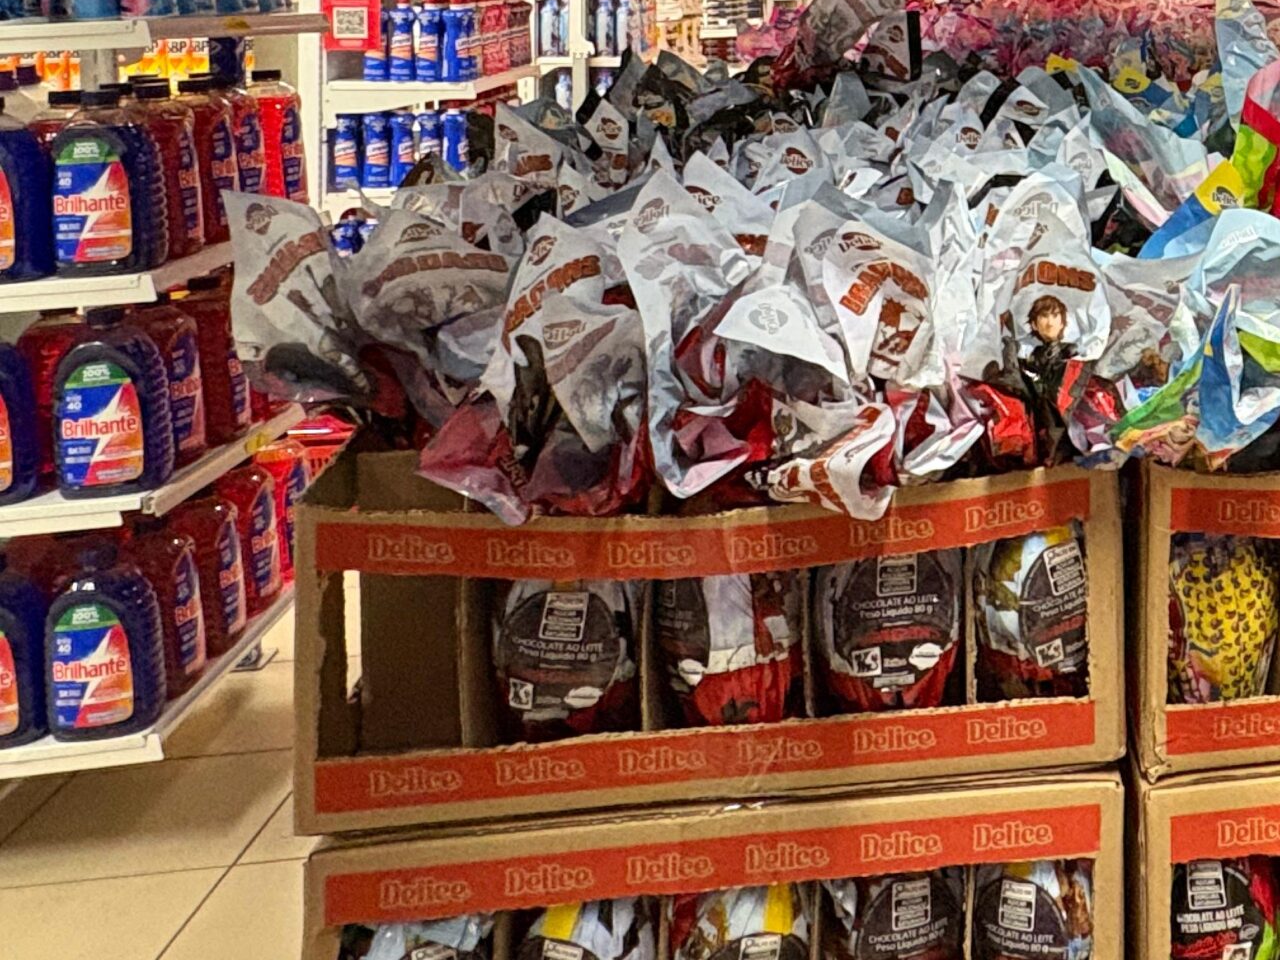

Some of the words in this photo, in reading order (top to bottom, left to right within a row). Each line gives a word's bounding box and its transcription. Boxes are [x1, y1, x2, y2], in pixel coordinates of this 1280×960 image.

[54, 194, 126, 215] Brilhante
[62, 417, 137, 439] Brilhante
[368, 537, 455, 564] Delice
[487, 538, 574, 568] Delice
[608, 539, 698, 567] Delice
[965, 500, 1044, 532] Delice
[903, 595, 916, 605] AO
[53, 657, 126, 681] Brilhante
[371, 767, 462, 797] Delice
[497, 755, 585, 786] Delice
[619, 743, 706, 774] Delice
[854, 726, 935, 752] Delice
[967, 715, 1046, 744] Delice
[381, 878, 472, 909] Delice
[506, 864, 594, 895] Delice
[627, 852, 714, 883] Delice
[745, 843, 828, 872] Delice
[861, 832, 942, 861] Delice
[974, 822, 1052, 851] Delice
